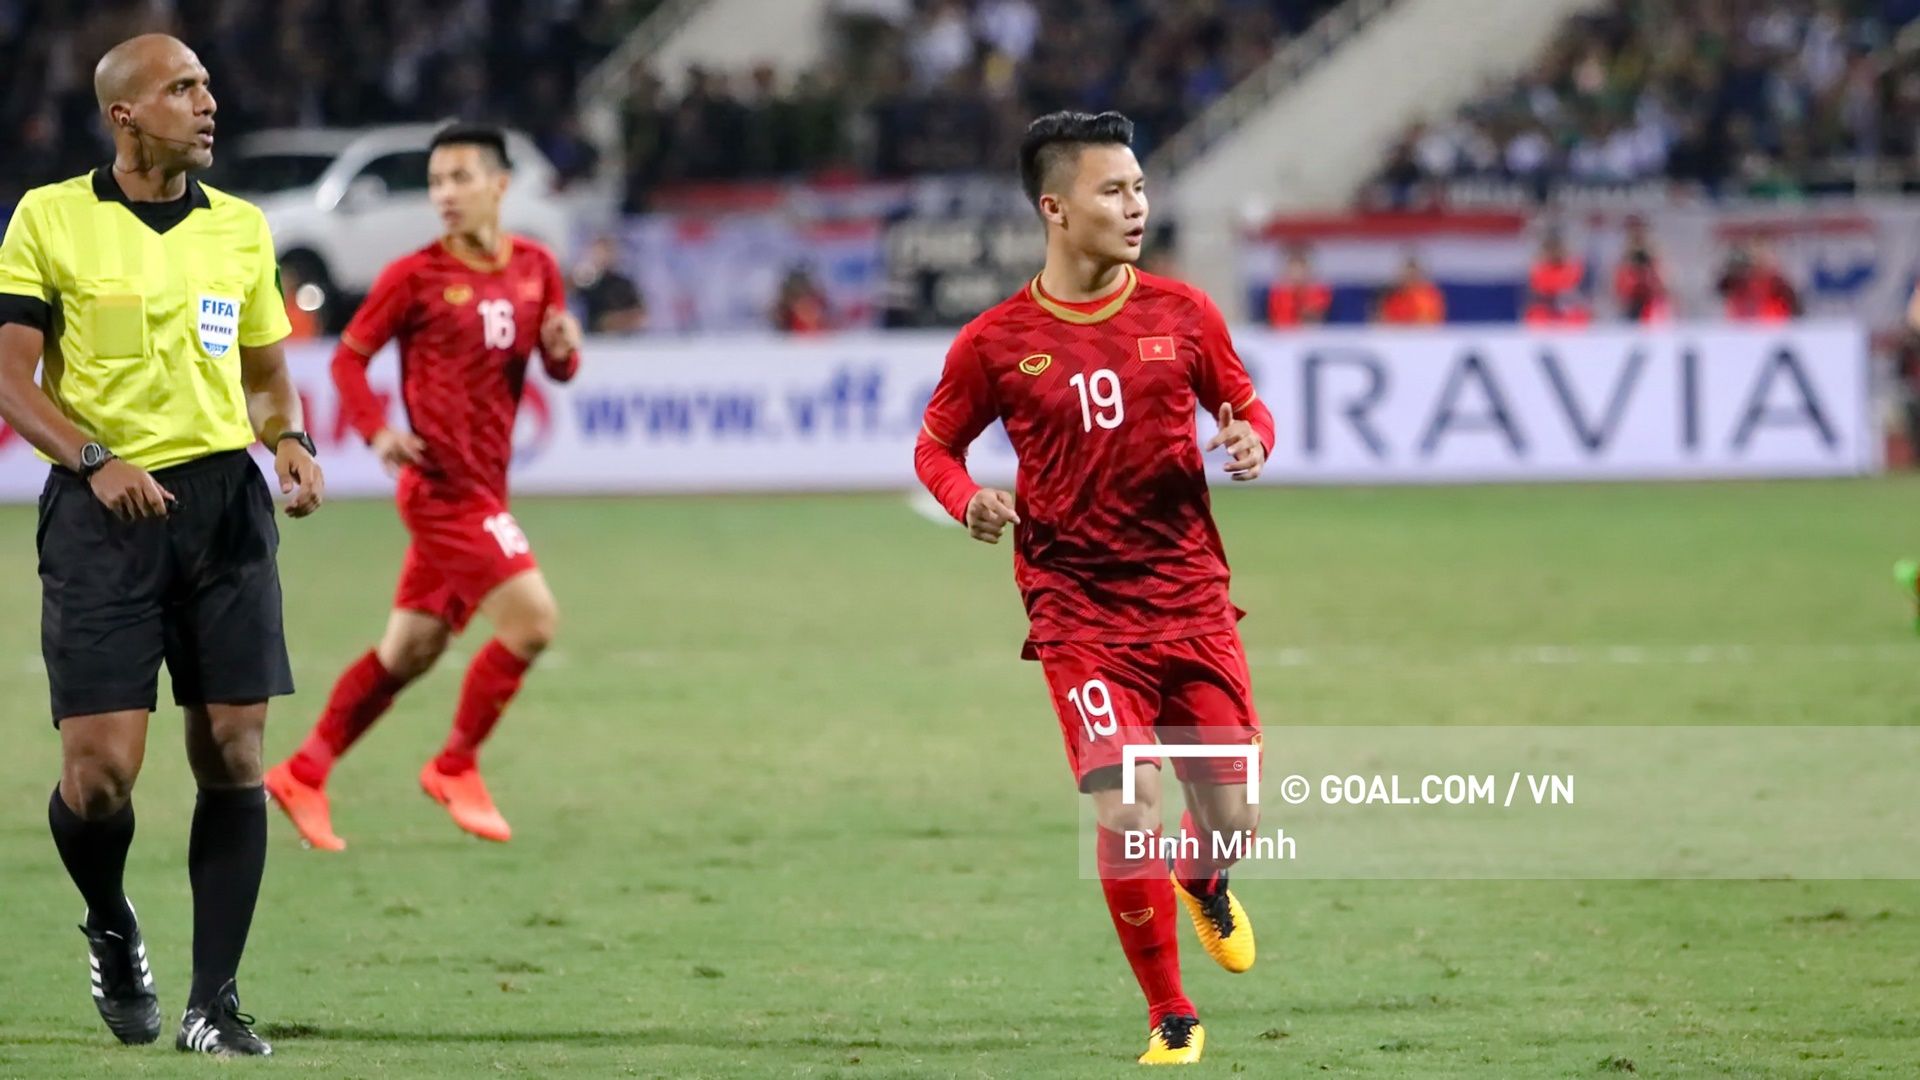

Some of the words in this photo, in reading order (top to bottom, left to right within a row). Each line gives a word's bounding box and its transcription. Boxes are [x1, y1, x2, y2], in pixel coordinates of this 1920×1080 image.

[200, 323, 233, 335] REFEREE
[202, 299, 234, 318] FIFA
[477, 299, 516, 350] 16
[1069, 368, 1125, 433] 19
[1243, 345, 1843, 458] RAVIA
[1067, 679, 1118, 742] 19
